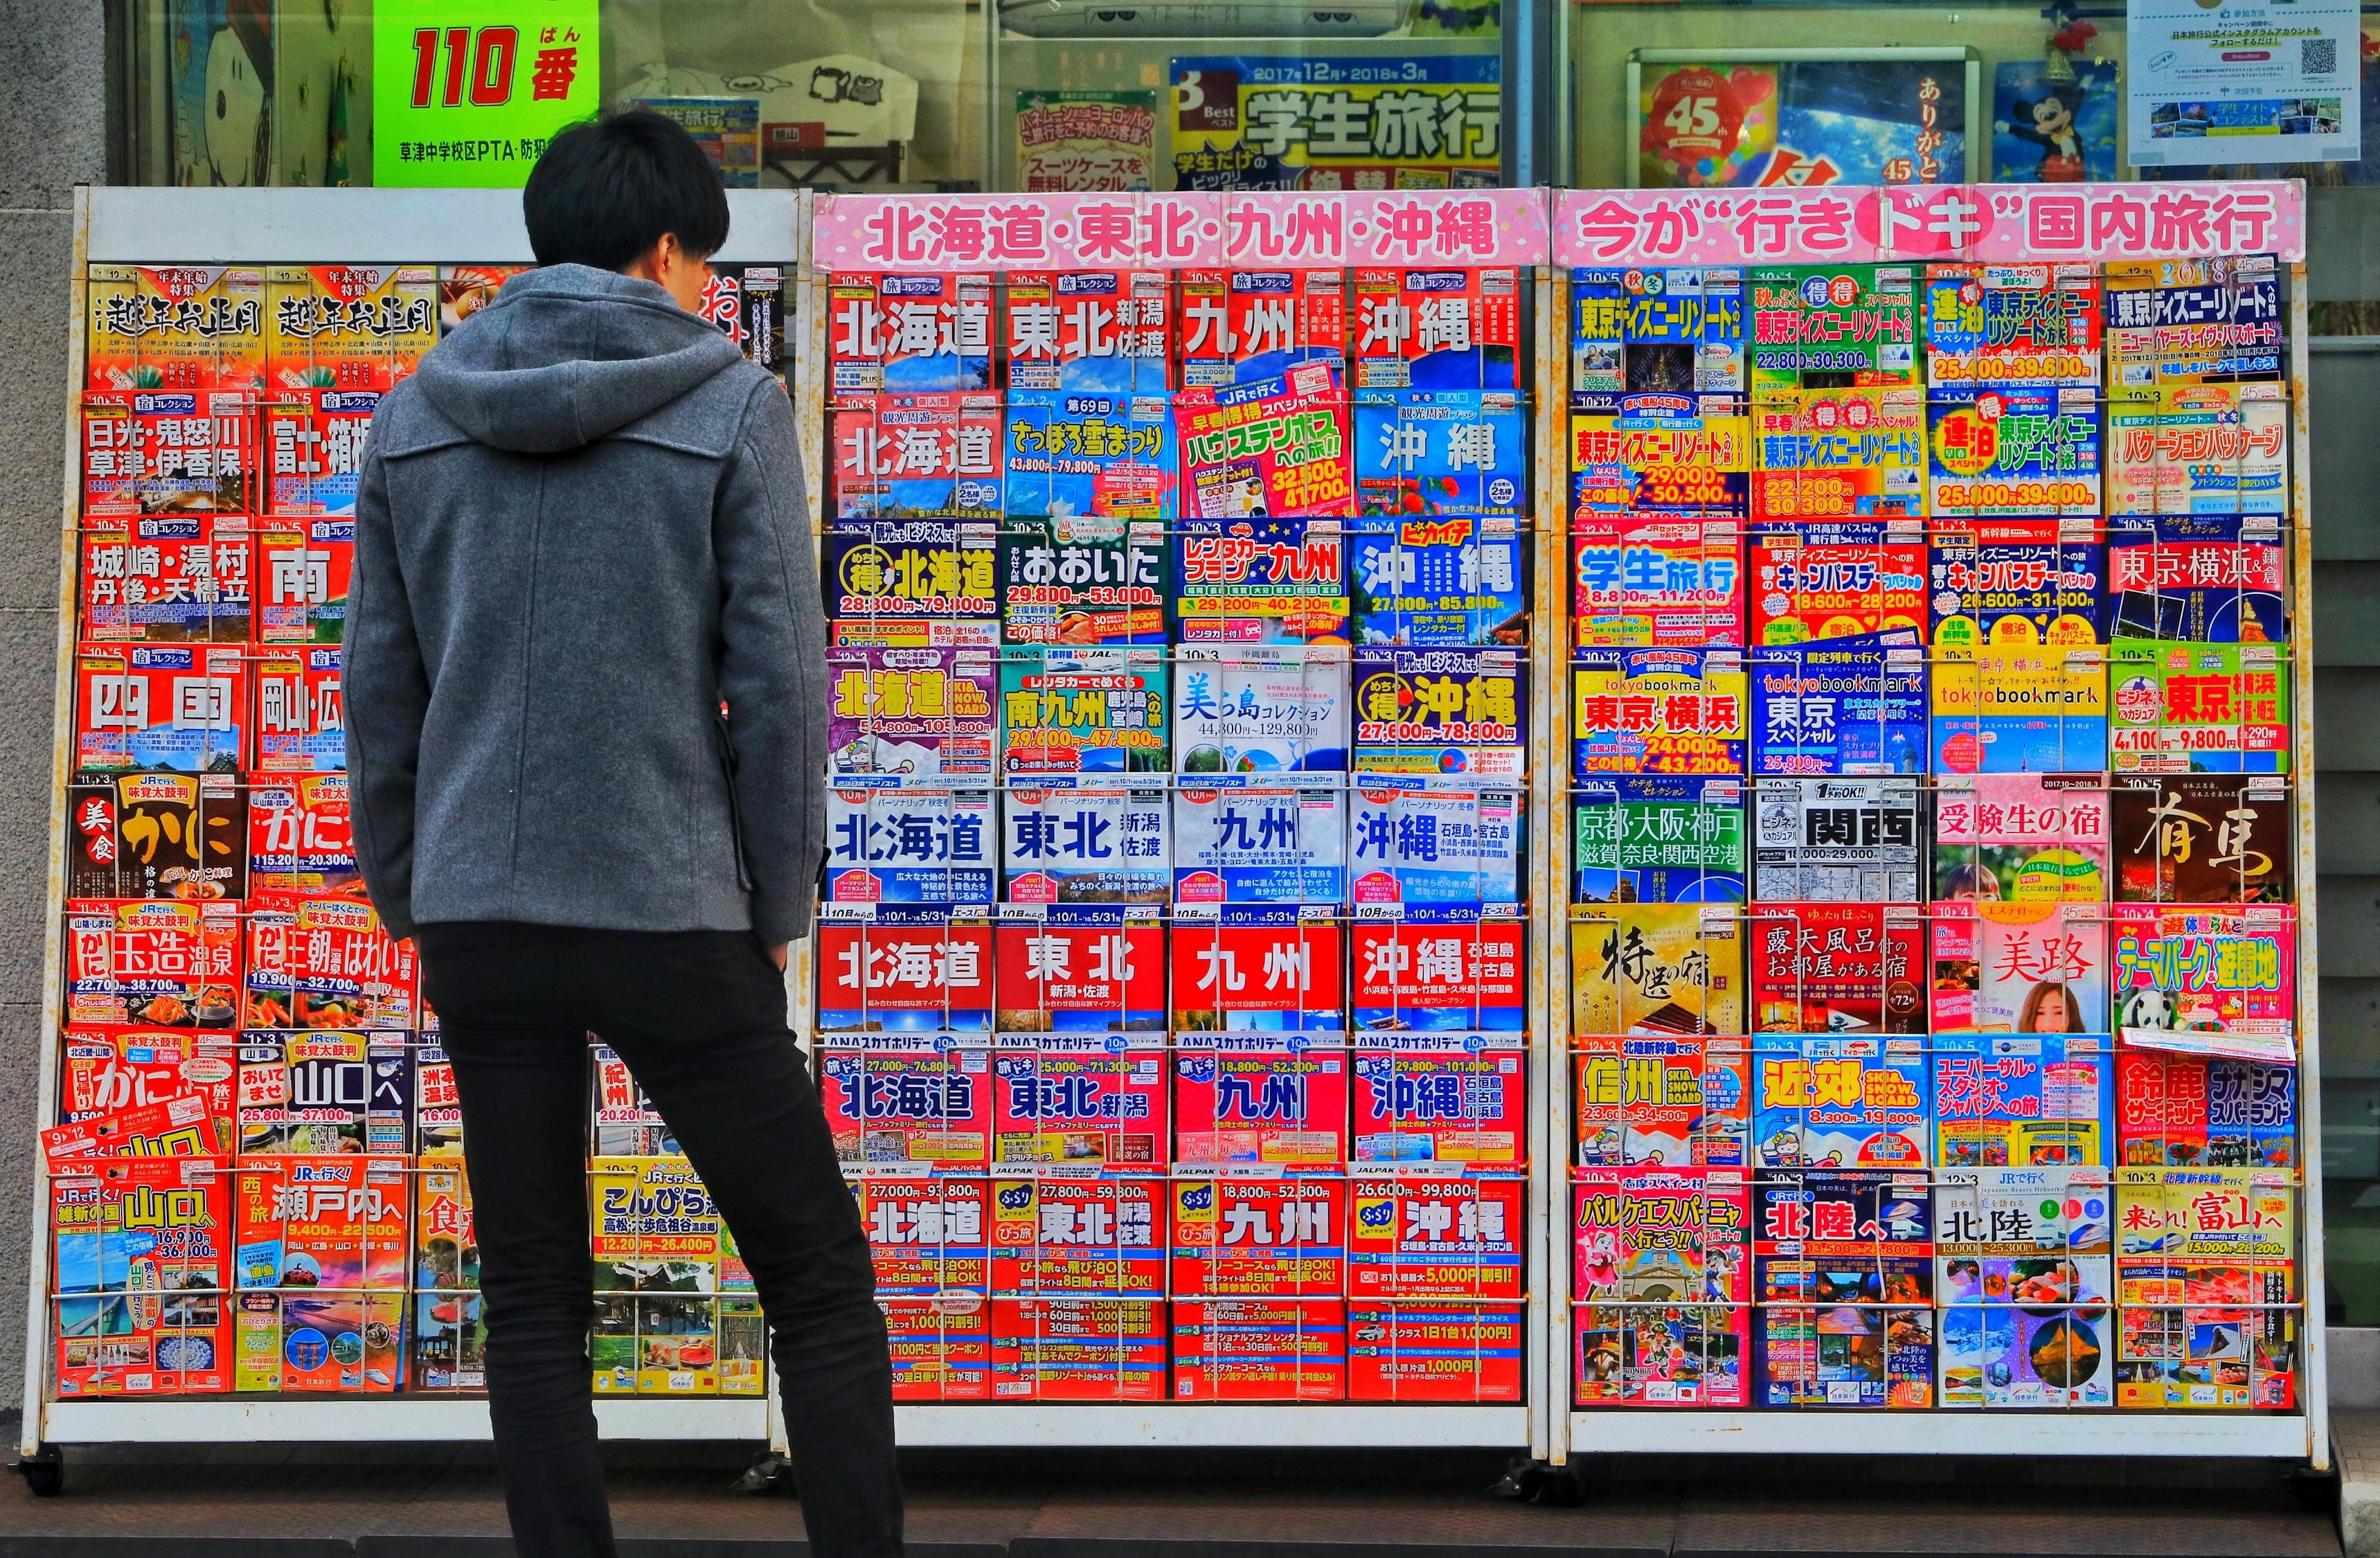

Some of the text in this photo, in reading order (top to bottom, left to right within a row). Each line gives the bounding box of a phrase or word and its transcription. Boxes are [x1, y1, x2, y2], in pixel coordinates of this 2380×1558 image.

[540, 26, 580, 42] ばん
[2172, 28, 2320, 39] 日本旅行公式インスタグラムアカウントを
[2212, 37, 2278, 46] フォローするだけ!
[410, 26, 519, 108] 110
[532, 47, 578, 100] 番
[1204, 106, 1236, 120] Best
[1246, 89, 1499, 156] 学生旅行
[2219, 103, 2267, 114] 学生フォト
[2219, 115, 2267, 125] コンテスト
[1030, 159, 1142, 174] スーツケースを
[1884, 159, 1912, 181] 45
[1028, 176, 1126, 191] 無料レンタル
[867, 199, 1496, 261] 北海道・東北・九州・沖縄
[158, 272, 207, 284] 年末年始
[329, 272, 378, 283] 年末年始
[2161, 262, 2226, 284] 2018
[170, 285, 194, 296] 特集
[2118, 285, 2266, 324] 東京ディズニーリゾート
[106, 296, 260, 334] 越年お正月
[278, 296, 431, 335] 越年お正月
[835, 301, 990, 357] 北海道
[1010, 299, 1163, 357] 東北 新潟
[1185, 298, 1294, 353] 九州
[1359, 298, 1471, 352] 沖縄
[1582, 298, 1734, 339] 東京ディズニーリゾート
[1755, 312, 1903, 344] 東京ディズニーリゾート
[1117, 330, 1165, 357] 佐渡
[1067, 400, 1110, 413] 第69回
[1224, 384, 1280, 405] JRで行く
[1625, 396, 1689, 410] 赤い風船45周年
[1401, 407, 1476, 419] 観光周遊プラン
[89, 420, 240, 447] 日光・鬼怒川
[1011, 419, 1165, 458] さっぽろ雪まつり
[1187, 409, 1339, 467] ハウステンボス
[1380, 423, 1496, 472] 沖縄
[1577, 430, 1722, 465] 東京ディズニーリゾート
[2124, 426, 2282, 462] バケーションパッケージ
[87, 449, 243, 477] 草津・伊香保
[844, 427, 994, 476] 北海道
[1277, 436, 1341, 468] への旅!!
[1765, 435, 1911, 468] 東京ディズニーリゾート
[1401, 520, 1473, 547] ピカイチ
[91, 545, 248, 578] 城崎・湯村
[1024, 547, 1159, 583] おおいた
[1185, 562, 1246, 582] プラン
[1270, 544, 1339, 580] 九州
[1362, 544, 1514, 595] 沖縄
[1580, 546, 1735, 593] 学生旅行
[2063, 552, 2086, 560] への旅
[2119, 548, 2251, 586] 東京・横浜
[2262, 547, 2278, 584] 鎌倉
[91, 578, 249, 604] 丹後・天橋立
[895, 550, 995, 600] 北海道
[1242, 650, 1280, 659] 沖縄離島
[836, 670, 945, 719] 北海道
[1030, 677, 1135, 687] レンタカーでめぐる
[1605, 679, 1718, 692] tokyobookmark
[1765, 674, 1923, 694] tokyobookmark
[1942, 687, 2097, 704] tokyobookmark
[2166, 674, 2231, 723] 東京
[2233, 673, 2275, 695] 横浜
[91, 676, 231, 731] 四国
[1007, 692, 1104, 728] 南九州
[1415, 677, 1516, 726] 沖縄
[1585, 695, 1738, 732] 東京・横浜
[1766, 698, 1836, 728] 東京
[1111, 710, 1145, 728] 宮崎
[1767, 728, 1835, 743] スペシャル
[1647, 737, 1727, 754] 24,000円
[128, 787, 188, 799] 味覚太鼓判
[80, 800, 114, 861] 美食
[1012, 812, 1160, 859] 東北 新潟
[1213, 808, 1298, 850] 九州
[1441, 823, 1509, 839] 石垣島・宮古島
[1582, 809, 1738, 841] 京都・大阪・神戸
[1807, 809, 1917, 845] 関西
[1939, 805, 2100, 834] 受験生の宿
[2135, 794, 2272, 875] 有馬
[835, 813, 983, 861] 北海道
[1120, 839, 1161, 857] 佐渡
[1357, 812, 1438, 861] 沖縄
[1581, 845, 1738, 866] 滋賀・奈良・関西空港
[1808, 911, 1874, 921] ゆったり ほっこり
[1767, 926, 1907, 954] 露天風呂付の
[838, 941, 981, 988] 北海道
[1026, 935, 1134, 981] 東北
[1197, 942, 1309, 991] 九州
[1364, 938, 1514, 984] 沖縄 石垣島
[1468, 962, 1514, 977] 宮古島
[1602, 926, 1710, 998] 特選の宿
[1769, 956, 1906, 978] お部屋がある宿
[1994, 931, 2094, 984] 美路
[1050, 985, 1109, 998] 新潟・佐渡
[296, 1044, 357, 1057] 味覚太鼓判
[1623, 1041, 1700, 1055] 北陸新幹線で行く
[295, 1064, 402, 1105] 山口へ
[605, 1064, 627, 1106] 紀州
[1219, 1075, 1305, 1119] 九州
[1373, 1076, 1501, 1118] 沖縄 石垣島
[1586, 1057, 1661, 1104] 信州
[1764, 1060, 1863, 1108] 近郊
[2126, 1063, 2204, 1100] 鈴鹿
[842, 1077, 972, 1118] 北海道
[1011, 1078, 1147, 1118] 東北 新潟
[1465, 1092, 1501, 1103] 宮古島
[1465, 1106, 1503, 1117] 小浜島
[2127, 1103, 2205, 1124] サーキット
[293, 1167, 350, 1181] JRで行く!
[1623, 1179, 1703, 1188] 志摩スペイン村
[2000, 1172, 2044, 1184] JRで行く
[57, 1204, 120, 1223] 維新の国
[123, 1188, 215, 1228] 山口へ
[272, 1185, 402, 1222] 瀬戸内へ
[1582, 1197, 1742, 1227] パルケエスパーニャ
[870, 1201, 981, 1244] 北海道
[1040, 1201, 1113, 1244] 東北
[1224, 1203, 1328, 1244] 九州
[1406, 1201, 1505, 1241] 沖縄
[1943, 1208, 2032, 1241] 北陸
